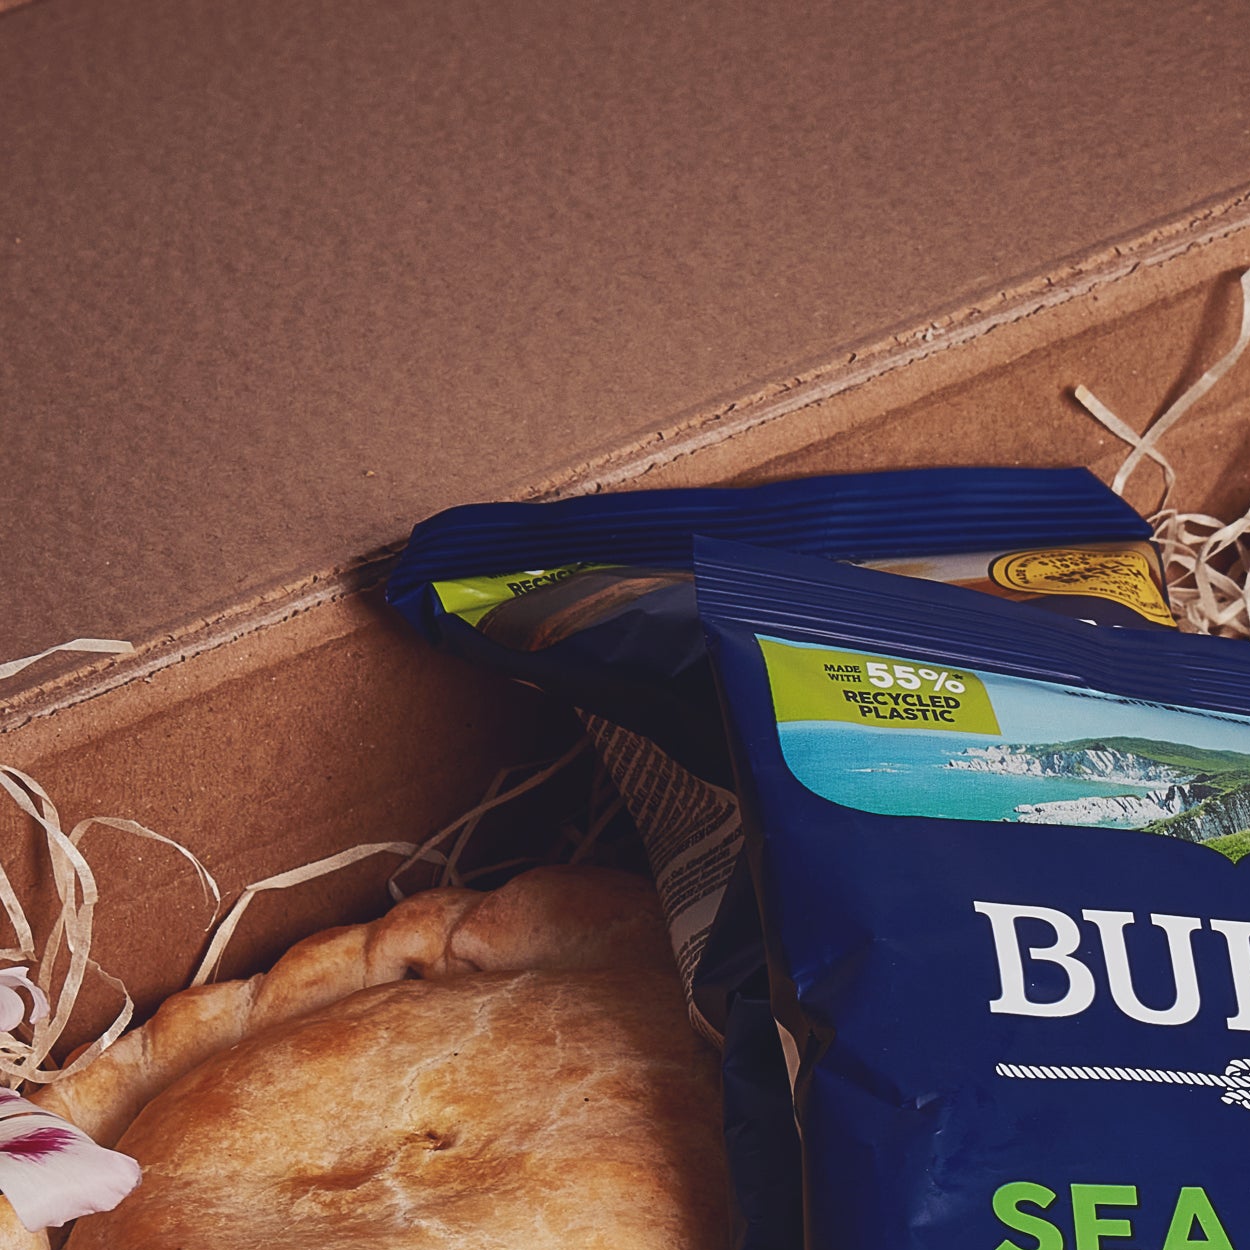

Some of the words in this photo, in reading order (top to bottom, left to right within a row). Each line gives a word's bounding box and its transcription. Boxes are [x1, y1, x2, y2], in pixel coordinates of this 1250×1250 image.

[507, 569, 574, 596] RECYC
[824, 663, 862, 673] MADE
[828, 673, 862, 683] WITH
[842, 690, 961, 709] RECYCLED
[859, 705, 956, 723] PLASTIC
